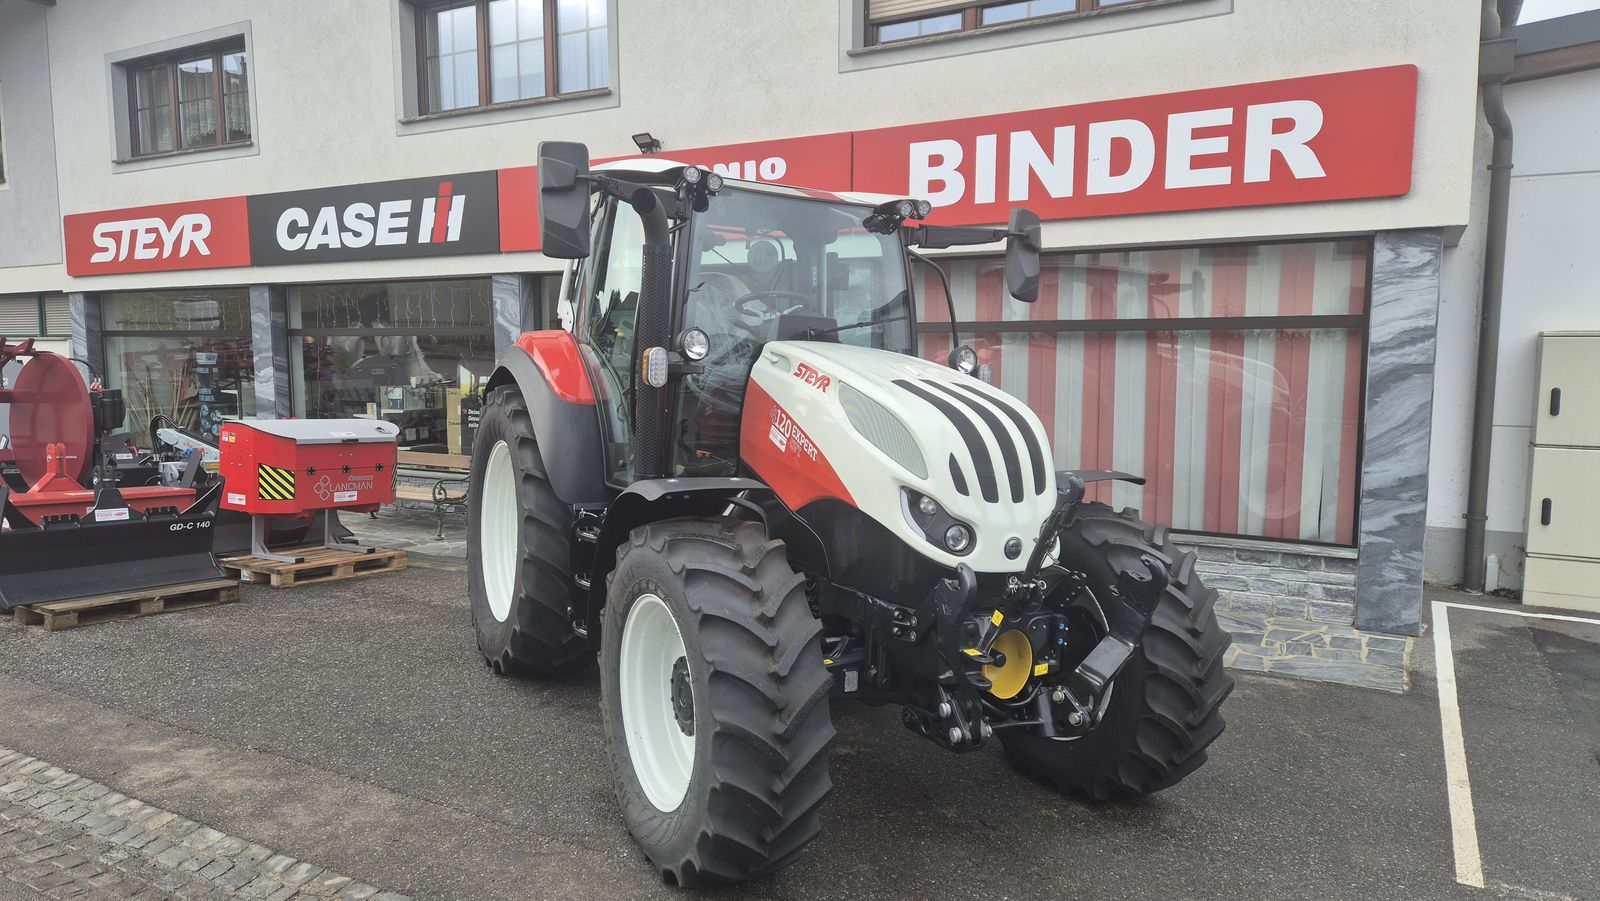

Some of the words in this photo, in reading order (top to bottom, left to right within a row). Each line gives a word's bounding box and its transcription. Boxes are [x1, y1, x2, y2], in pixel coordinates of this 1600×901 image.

[907, 98, 1327, 208] BINDER
[91, 213, 213, 264] STEYR
[276, 200, 412, 252] CASE
[792, 362, 832, 393] STEYR
[792, 425, 818, 462] EXPERT
[329, 481, 374, 492] LANCMAN
[169, 521, 194, 532] GD-C
[196, 520, 211, 529] 140
